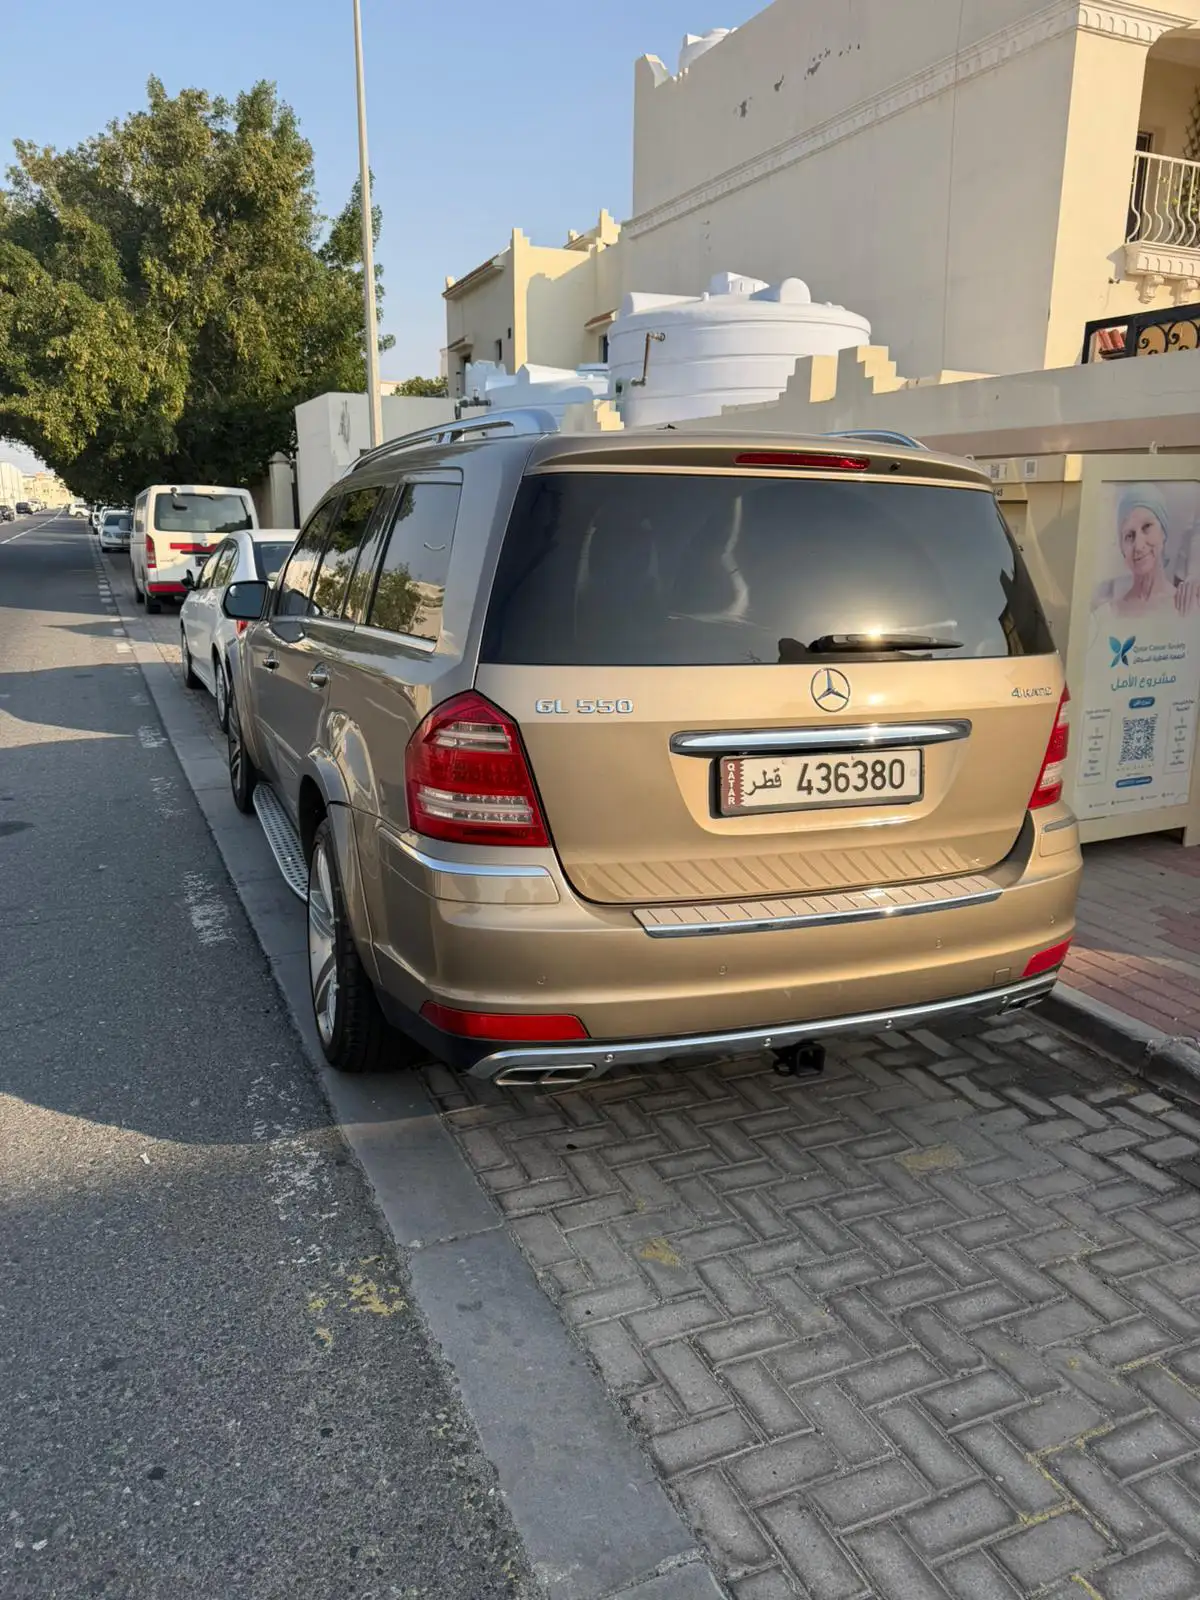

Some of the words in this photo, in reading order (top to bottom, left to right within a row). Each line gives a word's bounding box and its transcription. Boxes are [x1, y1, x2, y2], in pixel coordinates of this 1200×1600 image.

[1139, 673, 1176, 688] مشروع
[536, 699, 570, 714] GL
[576, 699, 634, 714] 550
[726, 762, 736, 806] QATAR
[744, 767, 782, 796] قطر
[796, 758, 905, 796] 436380
